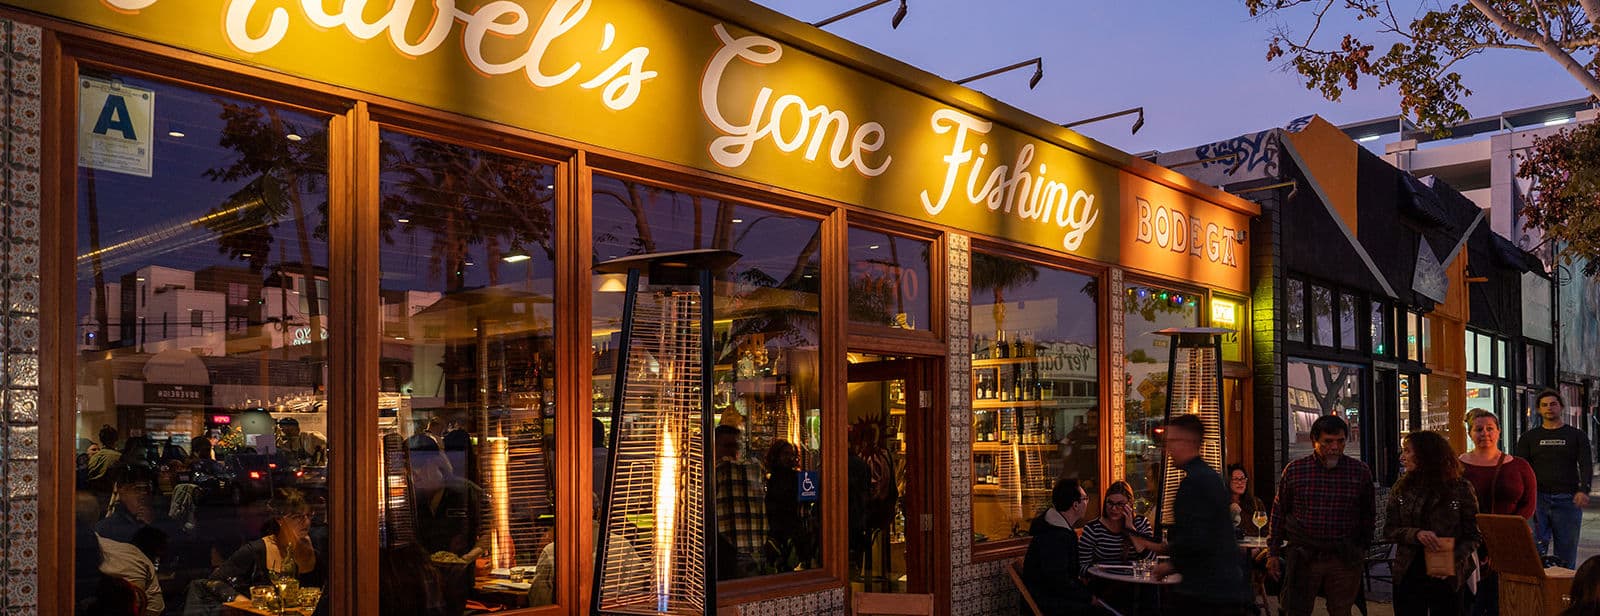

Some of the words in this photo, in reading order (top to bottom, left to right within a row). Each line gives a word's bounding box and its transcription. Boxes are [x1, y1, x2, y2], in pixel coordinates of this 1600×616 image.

[93, 93, 138, 140] A
[104, 0, 658, 110] el's
[701, 23, 892, 178] Gone
[921, 107, 1099, 251] Fishing
[1135, 195, 1238, 268] BODEGA
